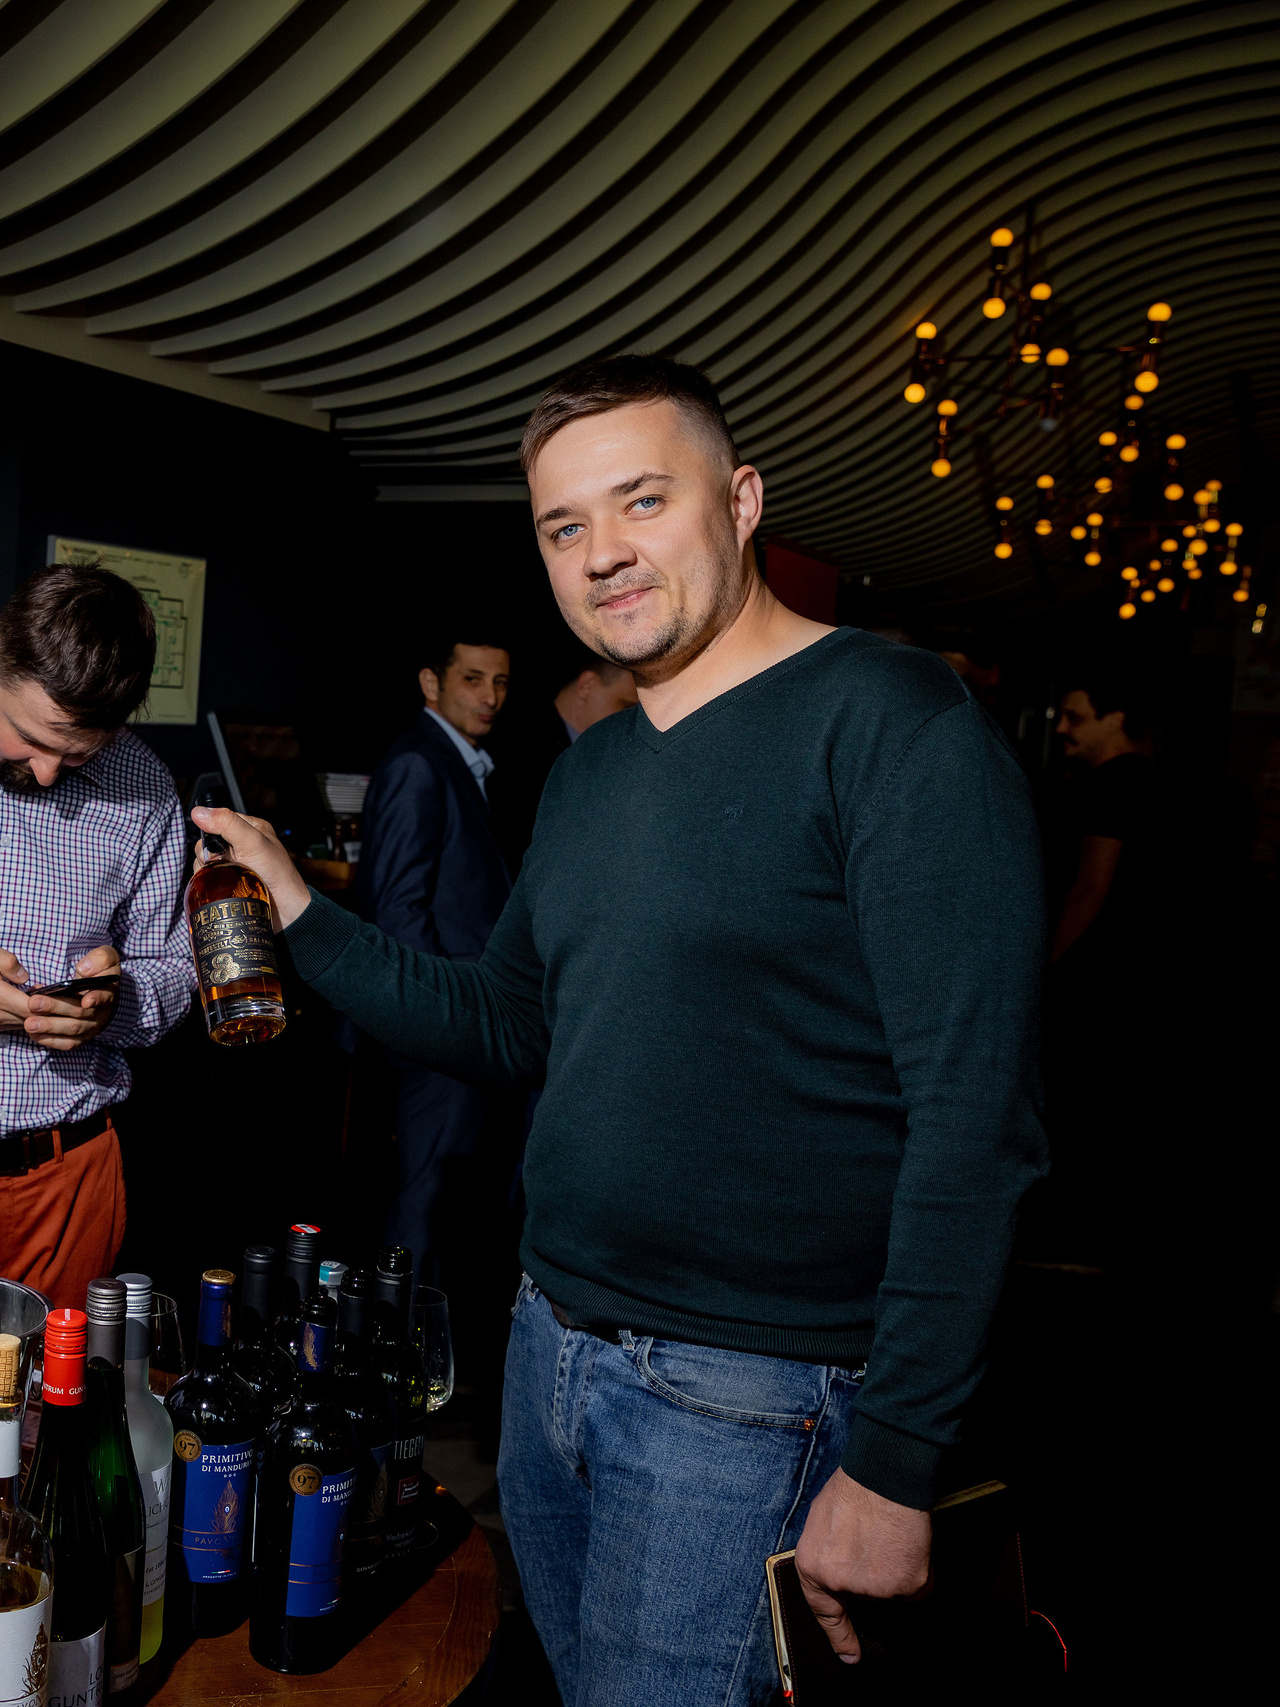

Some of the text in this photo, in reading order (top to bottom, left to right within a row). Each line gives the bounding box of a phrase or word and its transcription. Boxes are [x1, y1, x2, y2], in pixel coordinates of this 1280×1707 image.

[179, 1440, 195, 1456] 97
[201, 1449, 254, 1464] PRIMITIVO
[201, 1464, 211, 1473] DI
[297, 1474, 316, 1489] 97
[322, 1496, 332, 1504] DI
